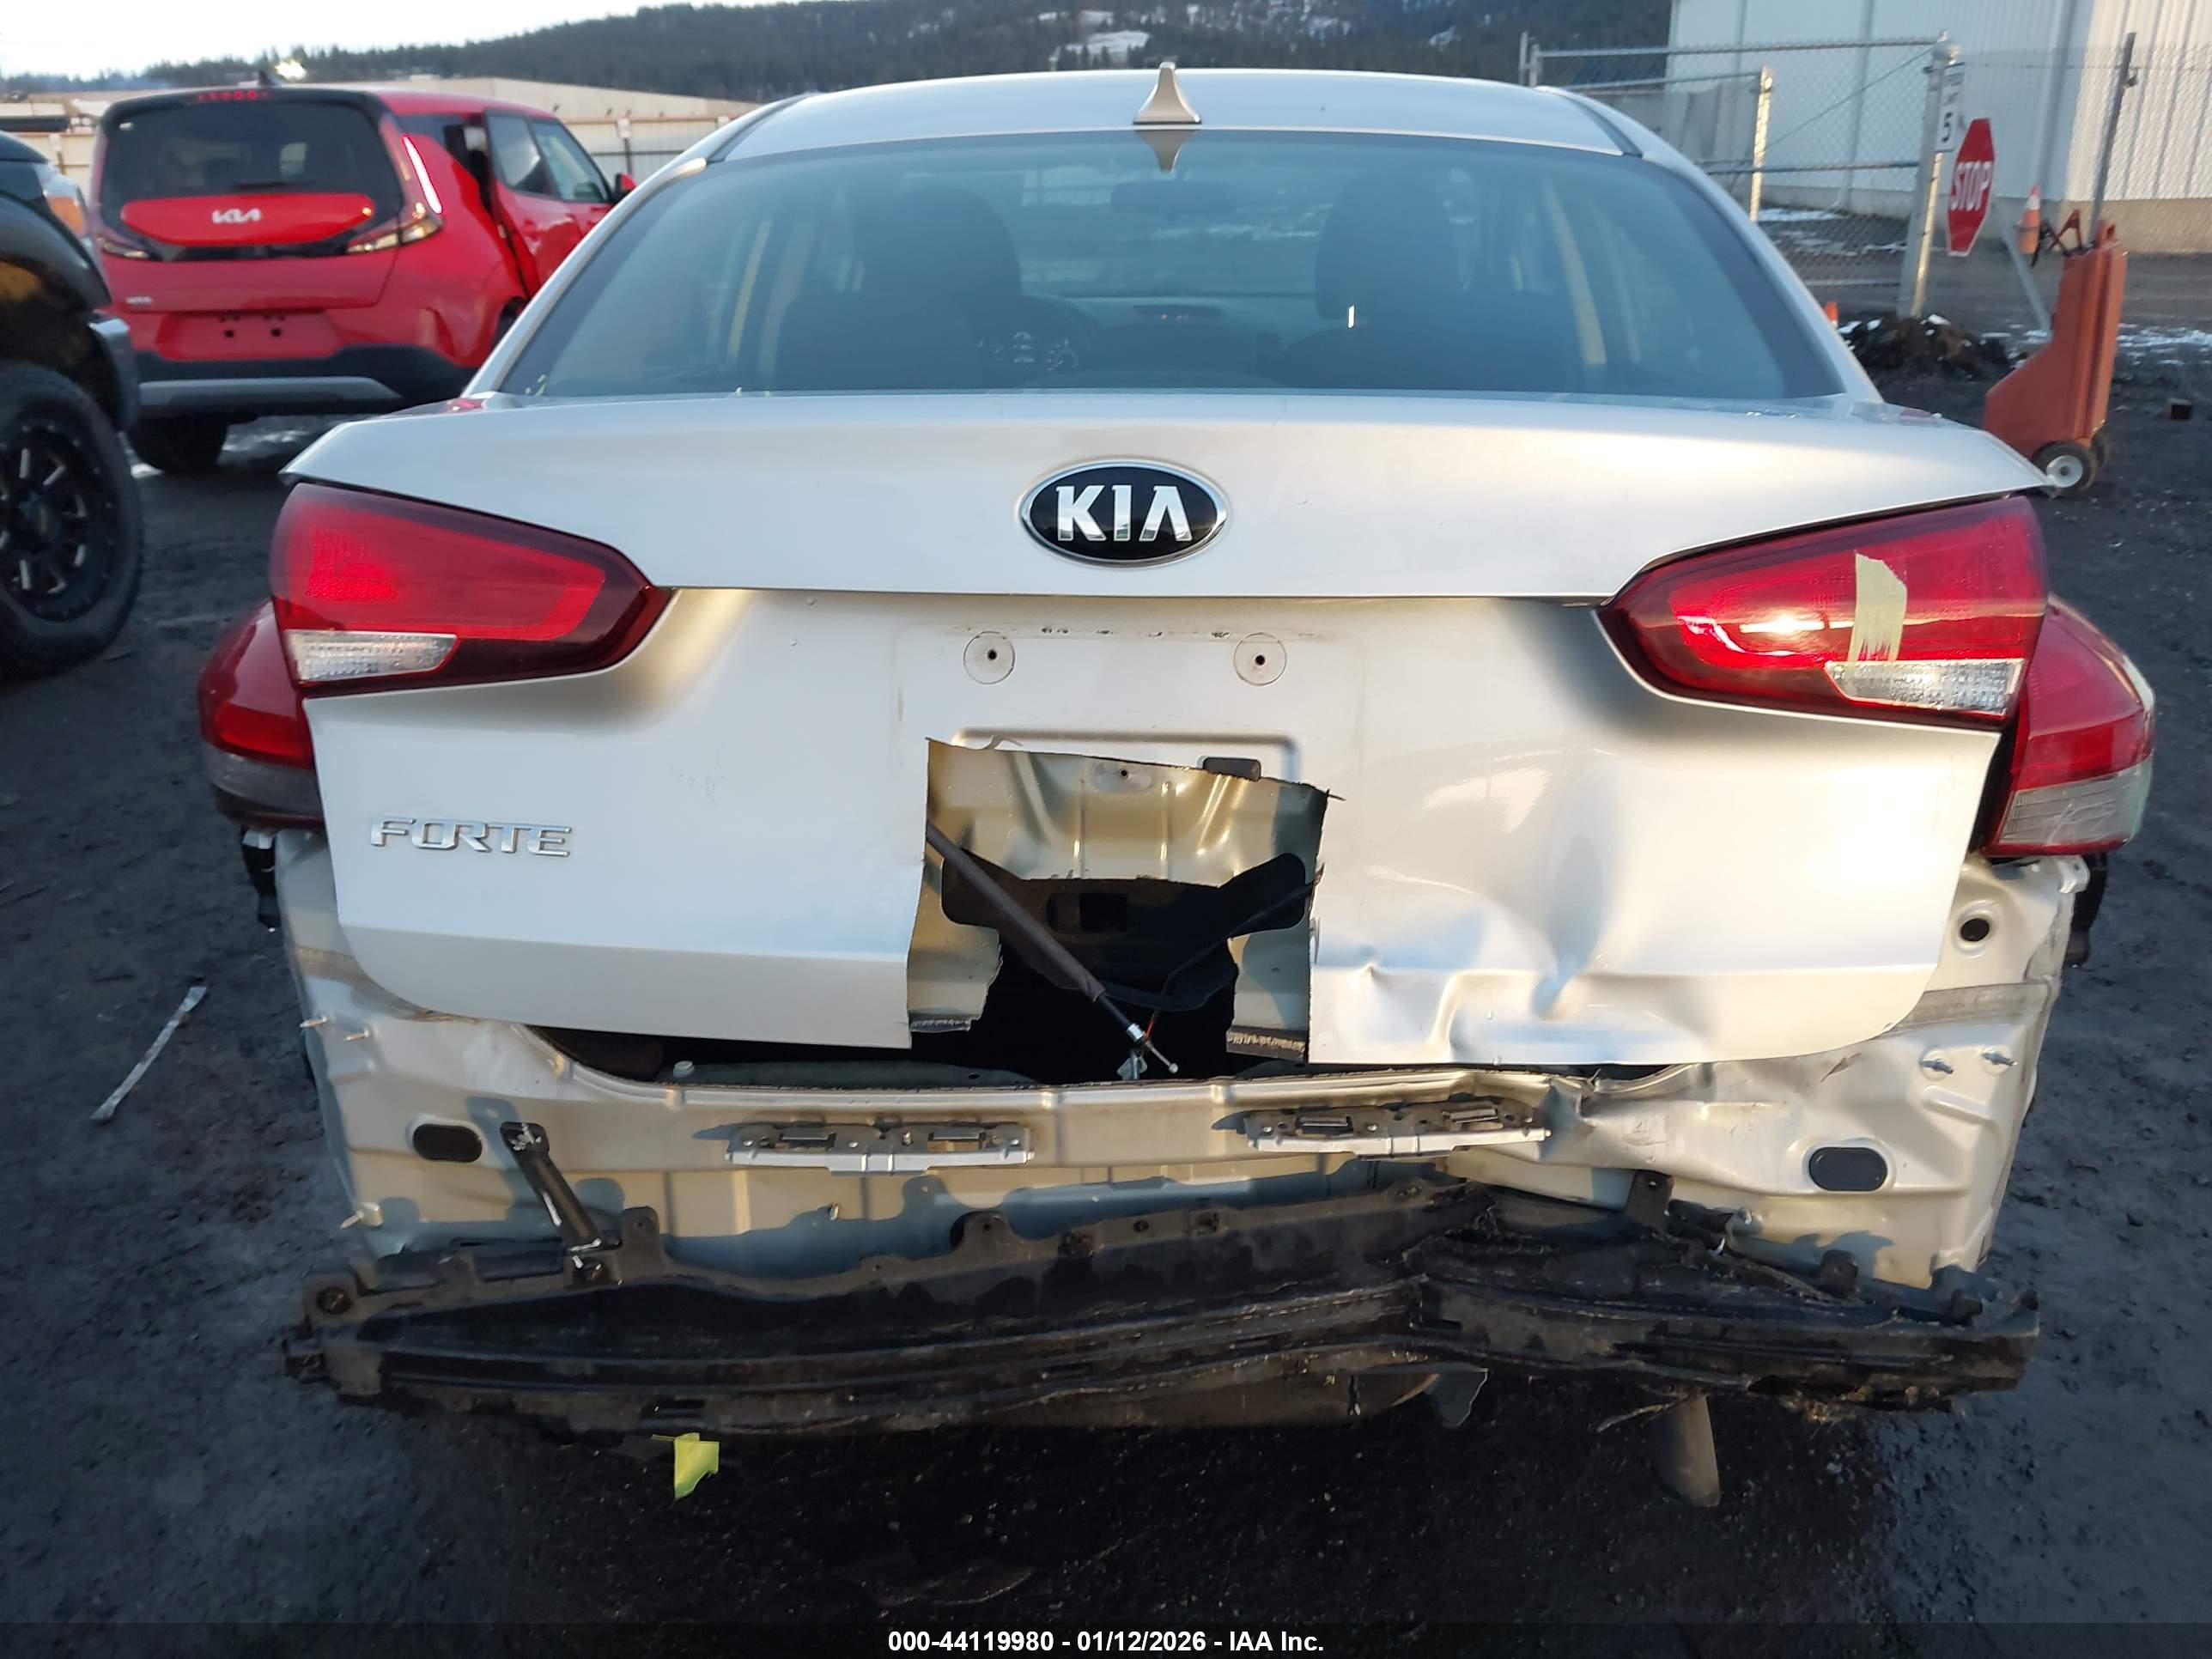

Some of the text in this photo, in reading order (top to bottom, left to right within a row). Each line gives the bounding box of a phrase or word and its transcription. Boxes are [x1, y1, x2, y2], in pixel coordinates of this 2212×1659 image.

[1942, 111, 1953, 143] 5
[1949, 160, 1993, 211] STOP
[211, 206, 261, 222] KIA
[1055, 484, 1193, 542] KIA
[371, 817, 572, 858] FORTE
